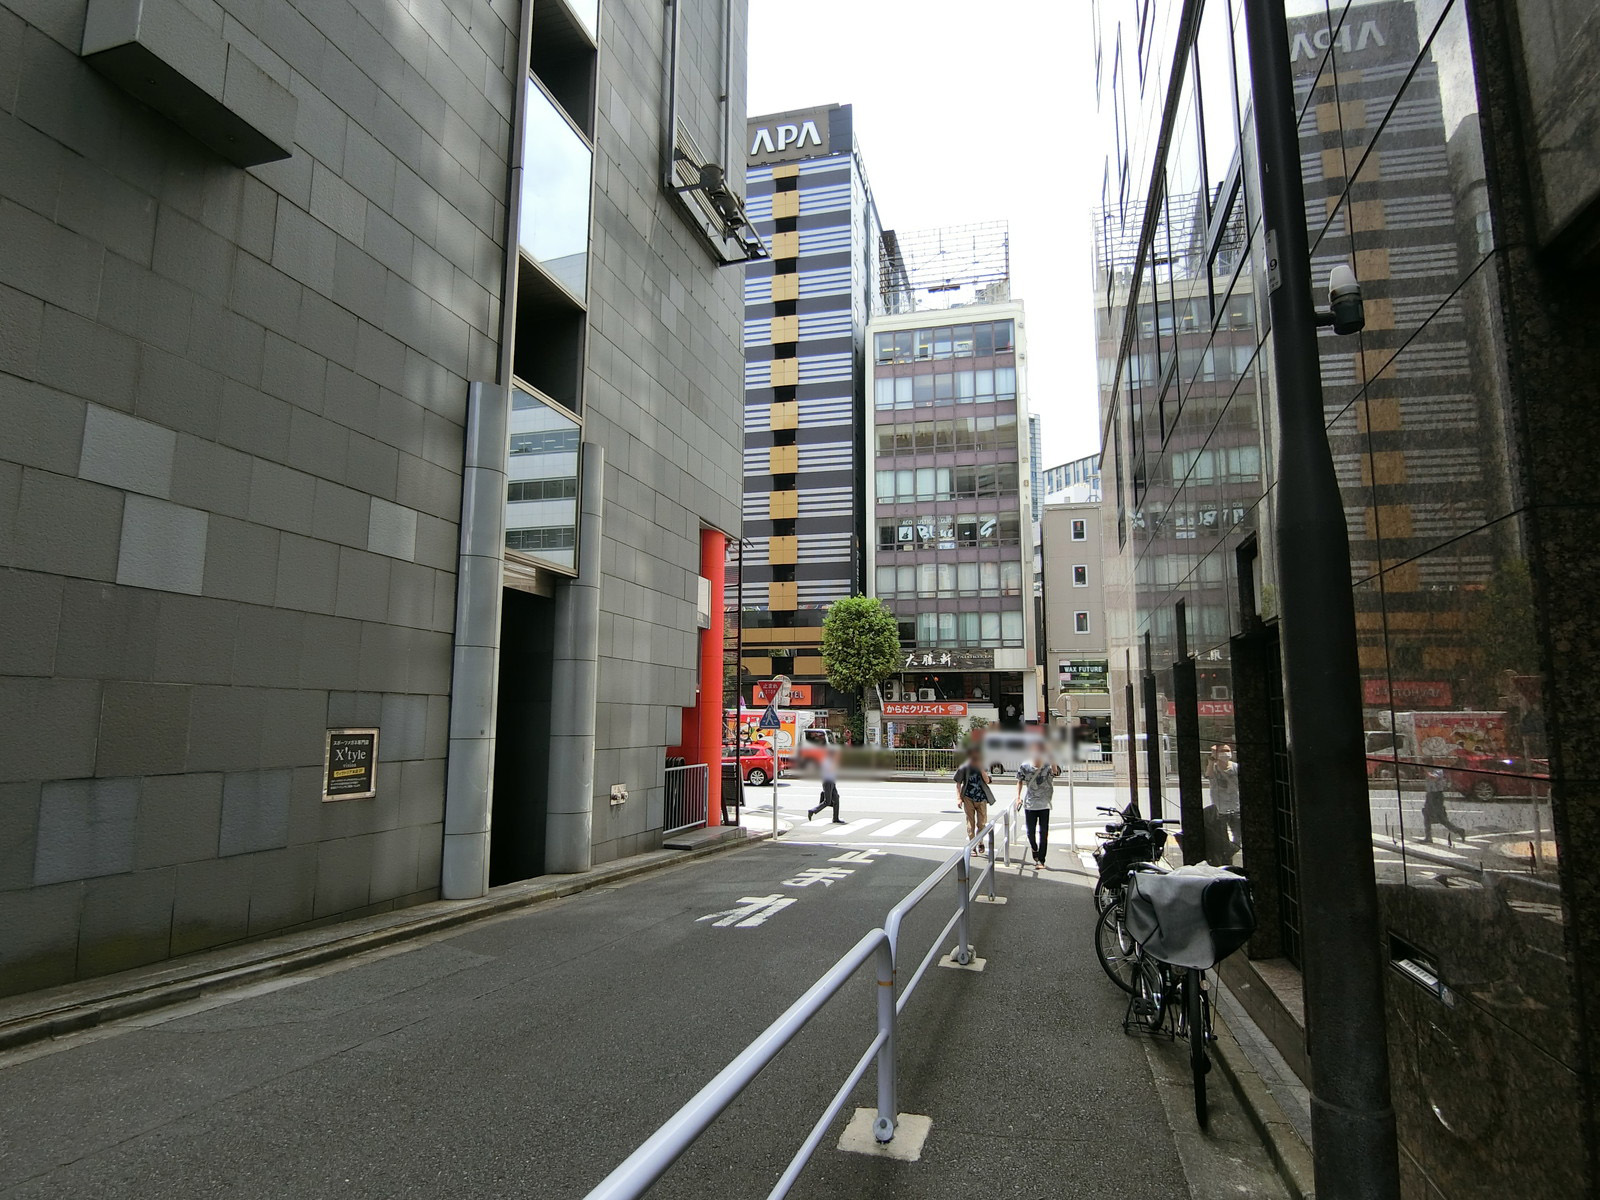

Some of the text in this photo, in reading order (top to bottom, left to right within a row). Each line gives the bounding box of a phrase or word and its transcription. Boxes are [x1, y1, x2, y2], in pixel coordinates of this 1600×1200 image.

[750, 120, 822, 156] APA
[886, 704, 945, 714] からだクリエイト
[335, 746, 366, 762] X'tyle
[694, 848, 889, 928] 止まれ
